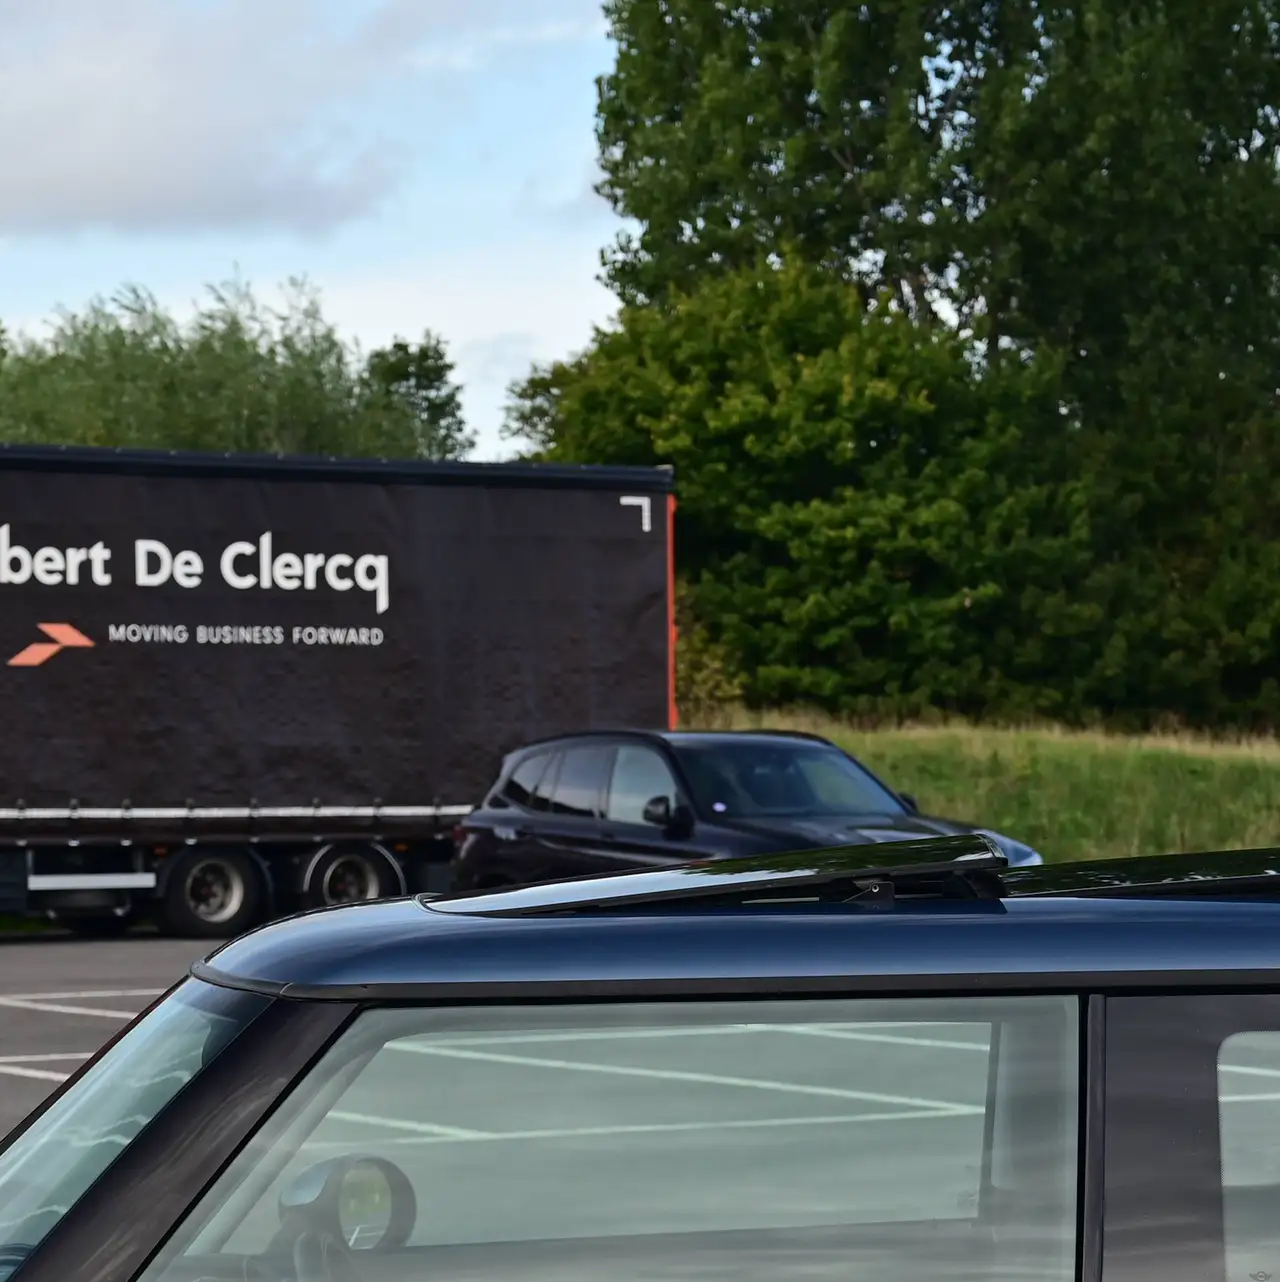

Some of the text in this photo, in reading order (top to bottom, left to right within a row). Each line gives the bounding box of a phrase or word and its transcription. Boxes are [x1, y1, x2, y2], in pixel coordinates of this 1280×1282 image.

[135, 538, 205, 588] De
[220, 531, 390, 614] Clercq
[107, 623, 385, 647] MOVING BUSINESS FORWARD
